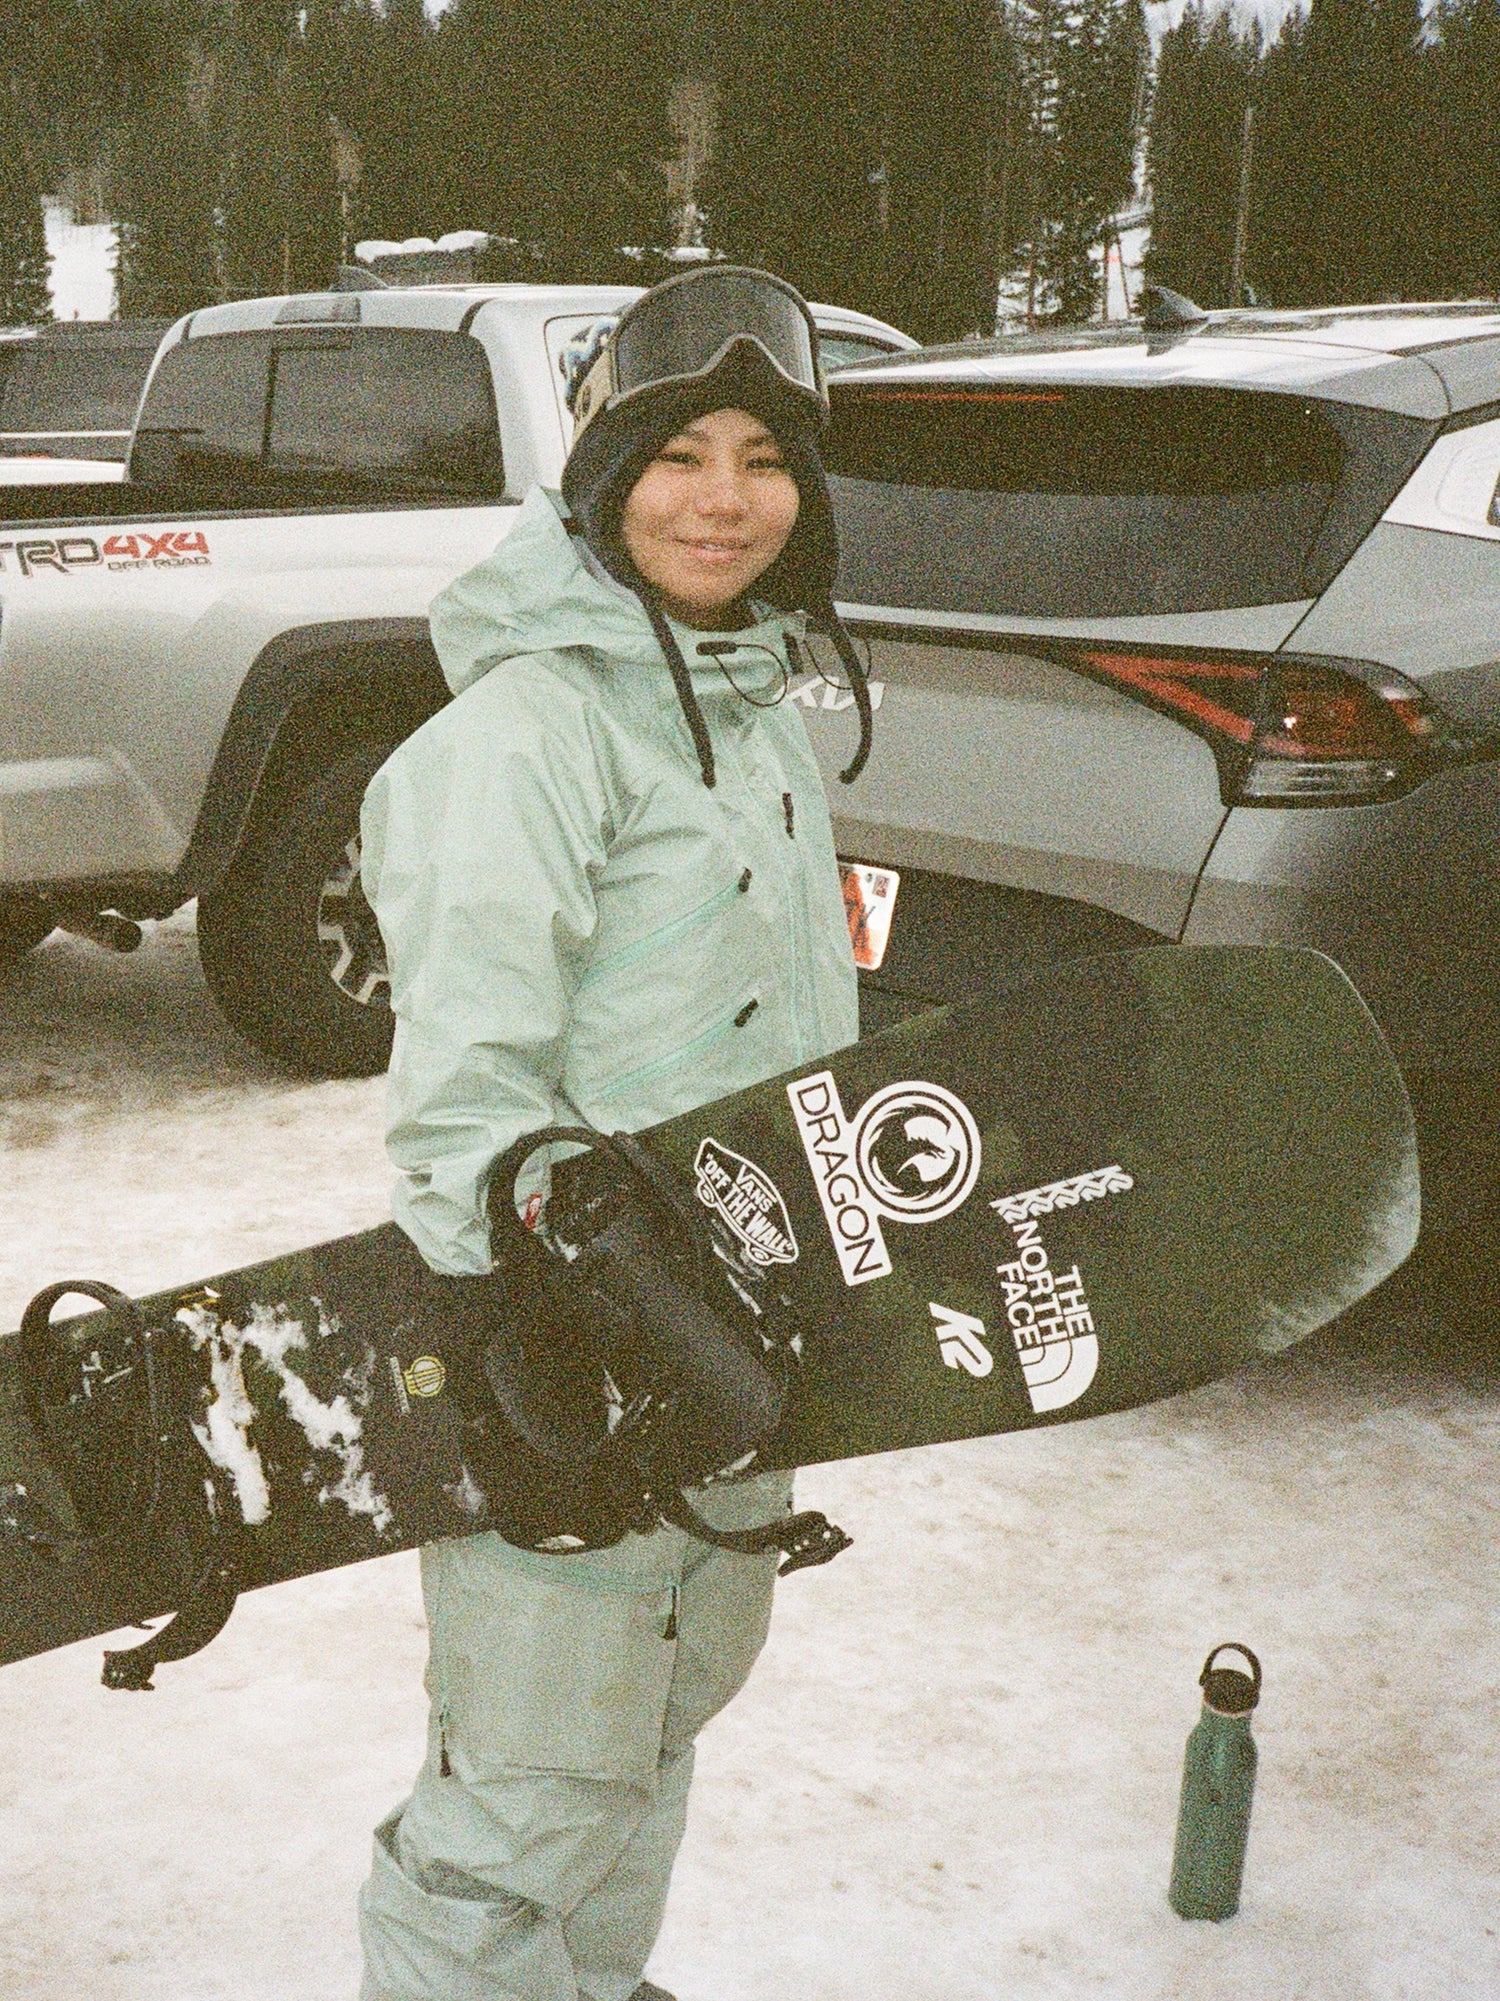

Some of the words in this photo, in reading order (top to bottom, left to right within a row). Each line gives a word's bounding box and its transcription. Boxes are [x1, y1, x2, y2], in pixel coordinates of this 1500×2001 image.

[103, 532, 209, 559] 4X4
[107, 559, 149, 571] OFF
[152, 556, 210, 568] ROAD
[722, 1183, 757, 1226] THE
[736, 1163, 777, 1213] VANS
[796, 1080, 883, 1278] DRAGON
[996, 1261, 1042, 1350] FACE
[1013, 1220, 1068, 1343] NORTH
[1055, 1264, 1095, 1336] THE
